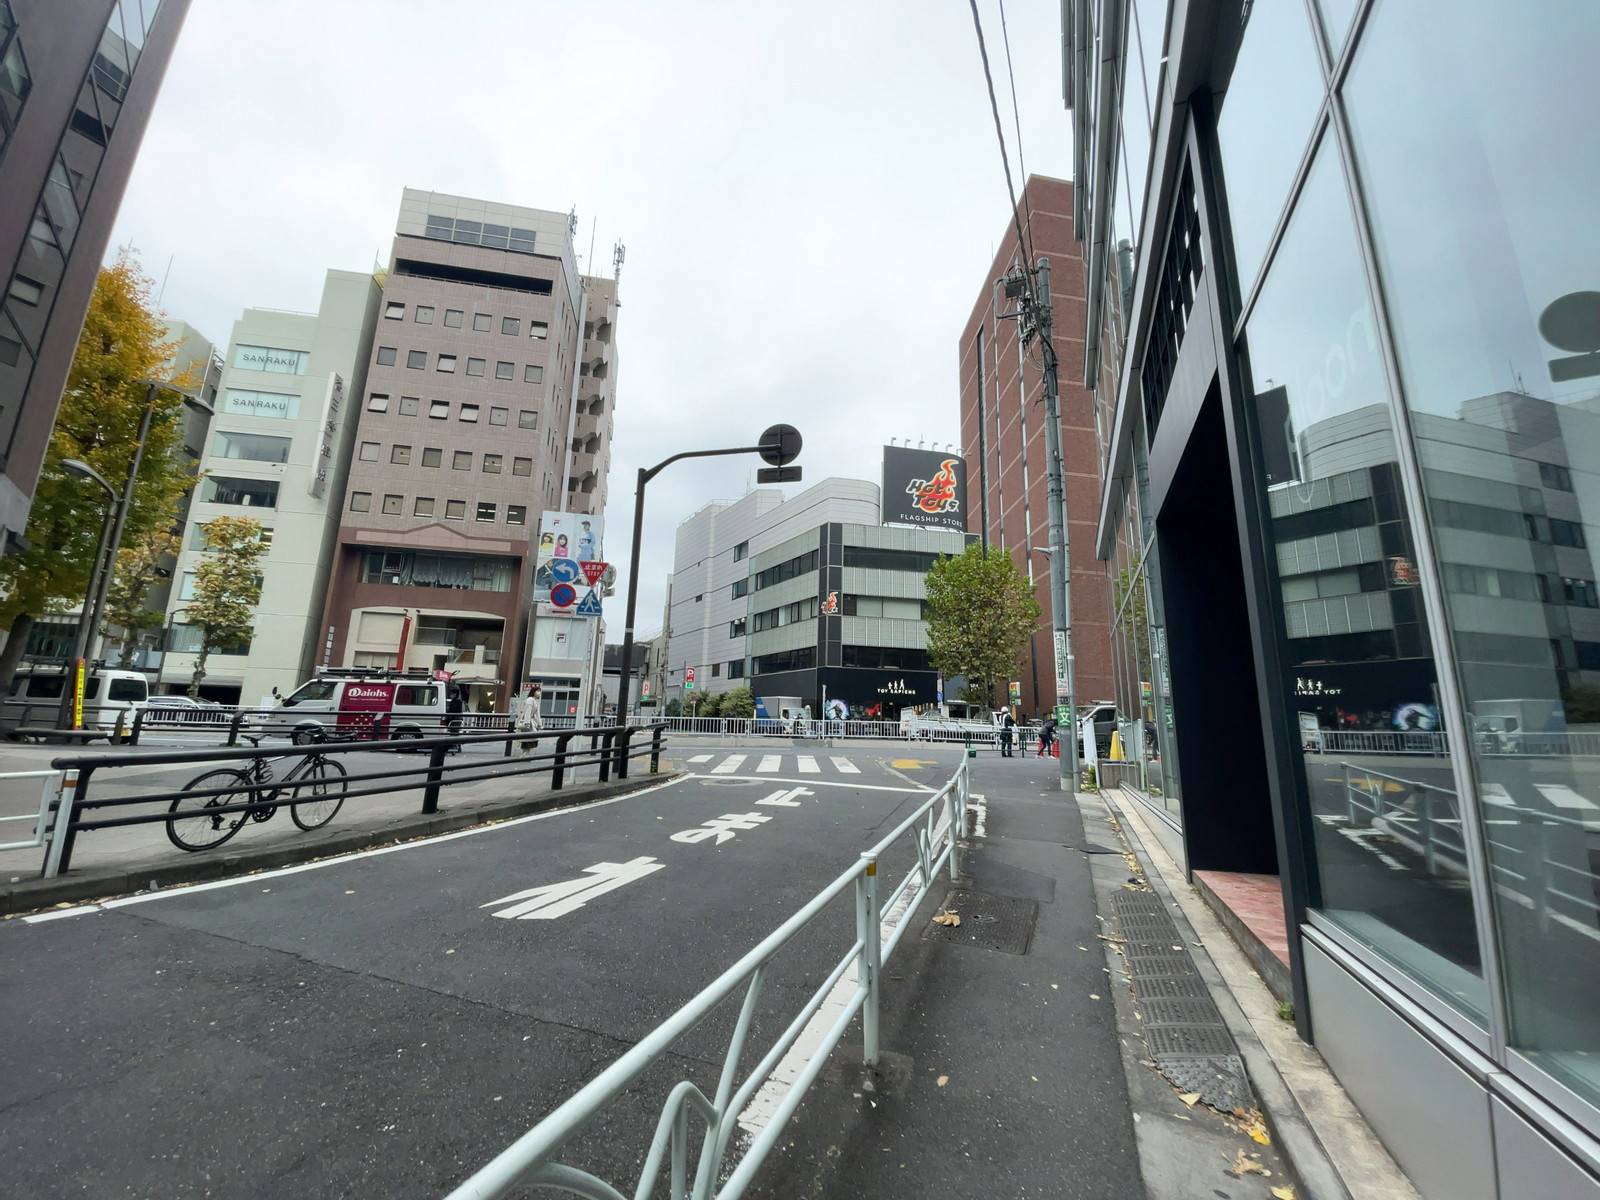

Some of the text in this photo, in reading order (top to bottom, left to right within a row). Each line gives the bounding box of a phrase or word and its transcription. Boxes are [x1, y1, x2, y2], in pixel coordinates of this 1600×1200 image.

[243, 354, 296, 366] SANRAKU
[232, 398, 286, 410] SANRAKU
[905, 478, 946, 495] Hot
[912, 495, 959, 513] Toys
[900, 513, 963, 528] FLAGSHIP STORE
[348, 687, 387, 697] Daiohs
